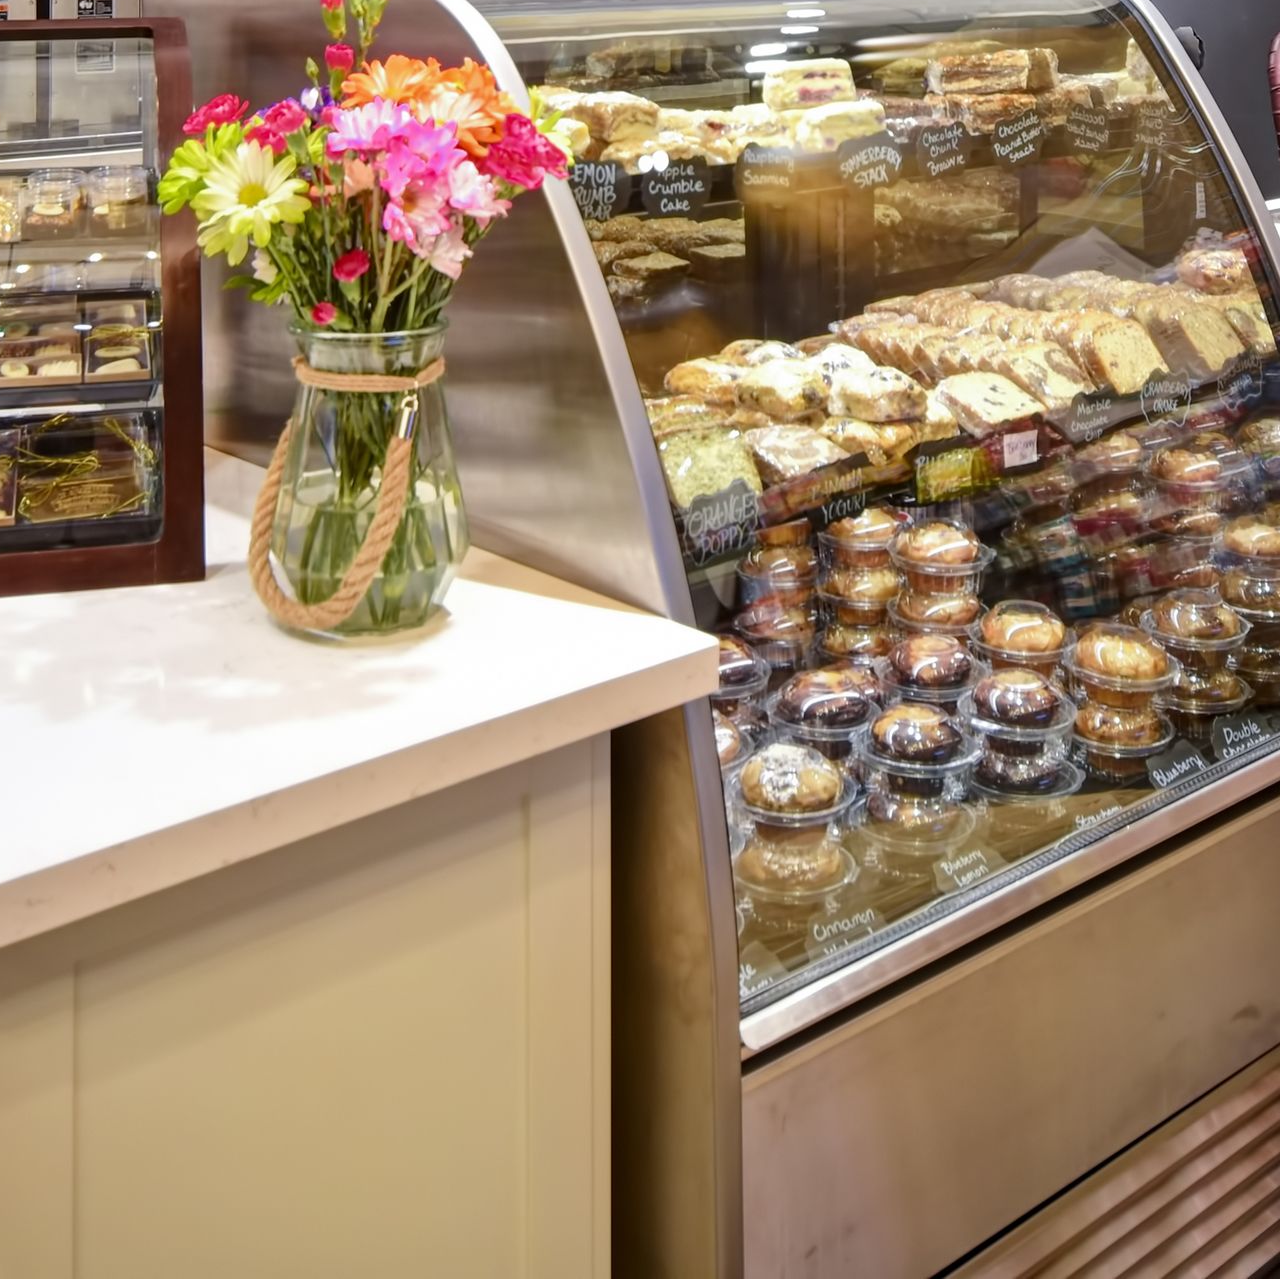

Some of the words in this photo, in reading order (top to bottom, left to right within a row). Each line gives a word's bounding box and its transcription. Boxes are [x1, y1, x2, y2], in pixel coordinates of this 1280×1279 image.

[922, 126, 963, 148] Chocolate
[998, 113, 1040, 138] Chocolate
[929, 139, 959, 157] Chunk
[993, 136, 1023, 158] Peanut
[1020, 125, 1046, 148] Butter
[744, 147, 794, 170] Raspberry
[840, 145, 903, 179] SUMMERBERRY
[1009, 144, 1036, 163] Stack
[573, 163, 616, 185] EMON
[853, 166, 889, 189] STACK
[649, 179, 705, 194] Crumble
[582, 205, 612, 220] BAR
[660, 198, 690, 212] Cake
[1077, 399, 1112, 416] Marble
[687, 492, 758, 538] ORANGE
[698, 526, 749, 564] POPPY
[1222, 720, 1262, 744] Double
[1153, 754, 1207, 786] Blueberry
[940, 848, 987, 875] Blueberry
[955, 865, 989, 888] Lemon
[814, 909, 875, 941] Cinnamon
